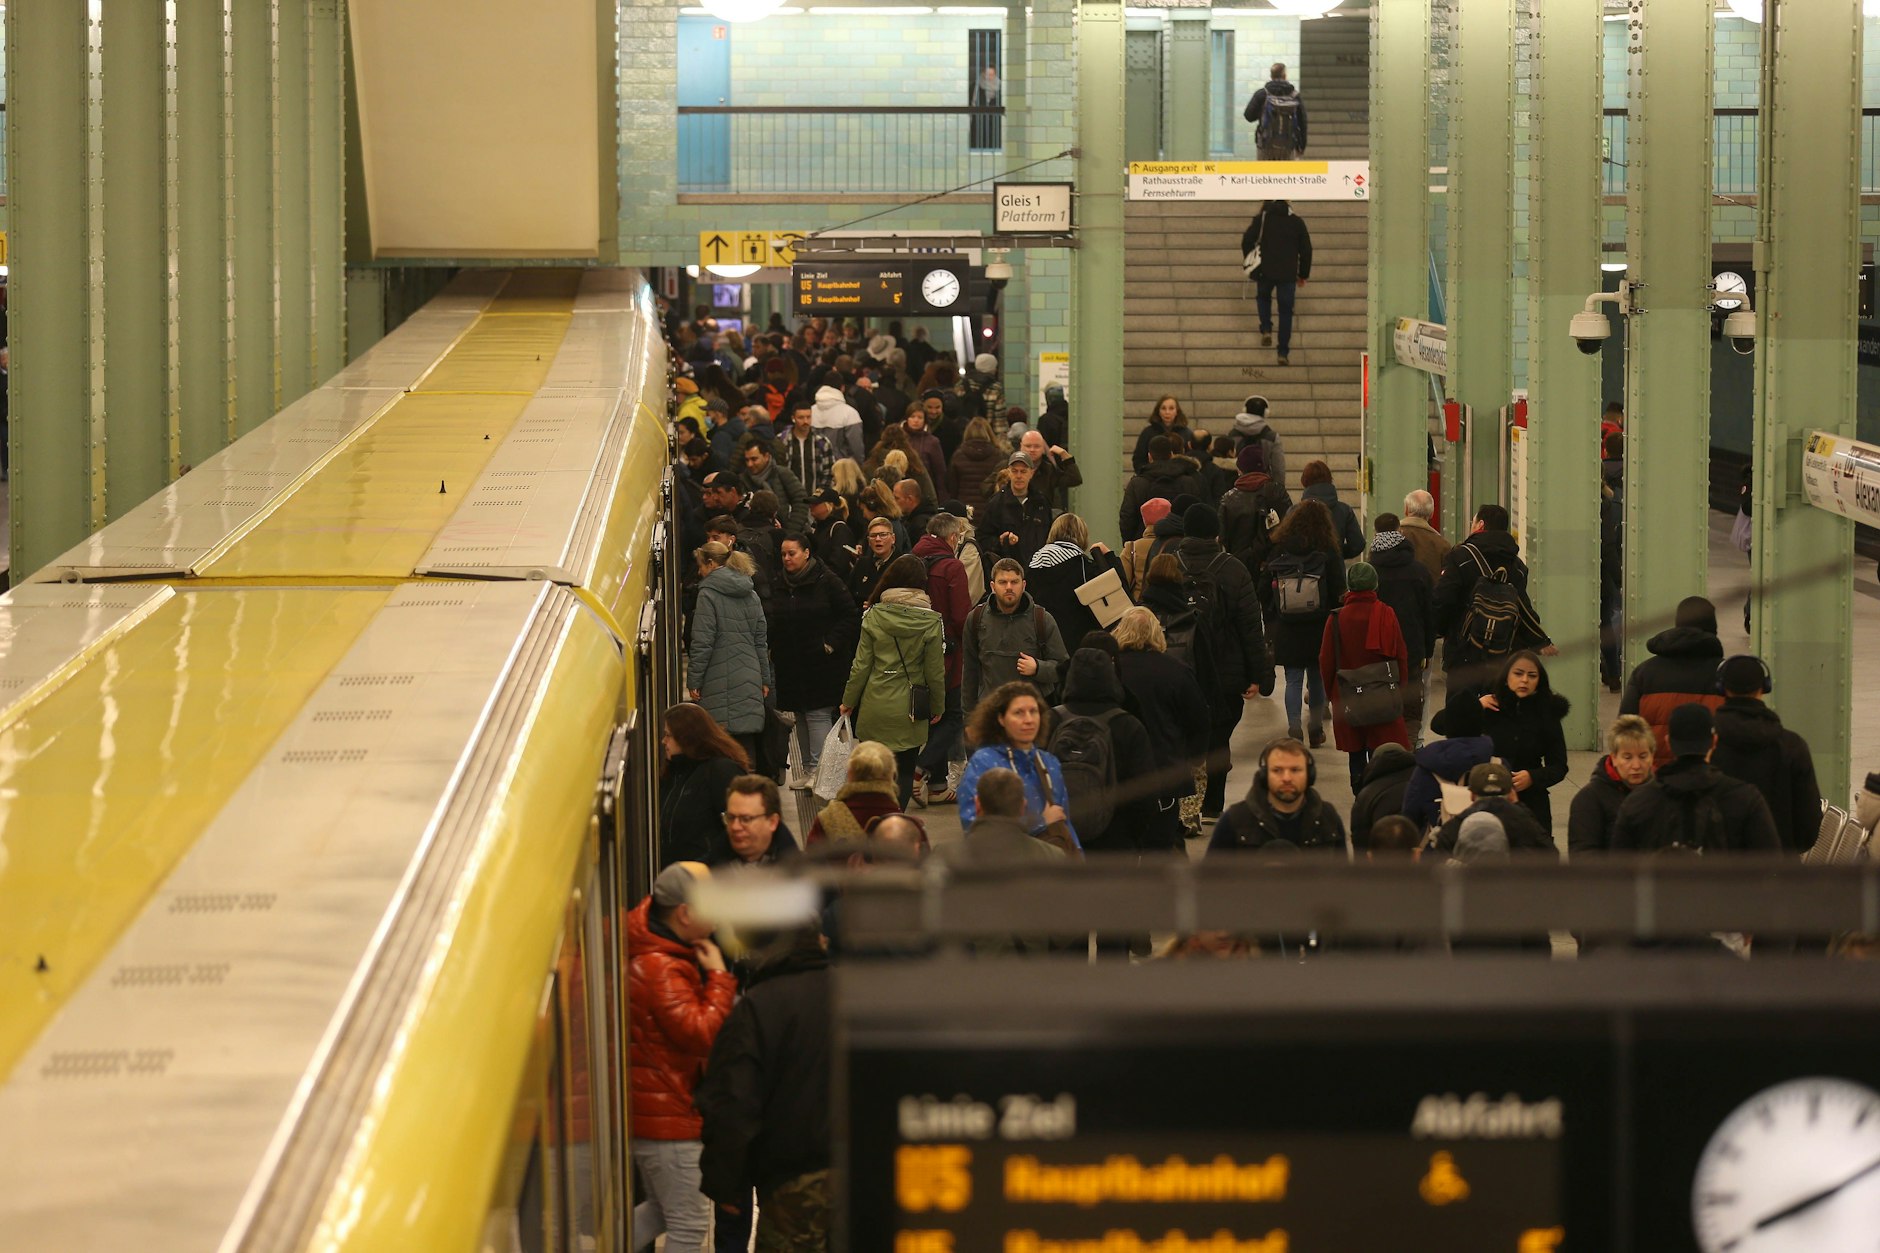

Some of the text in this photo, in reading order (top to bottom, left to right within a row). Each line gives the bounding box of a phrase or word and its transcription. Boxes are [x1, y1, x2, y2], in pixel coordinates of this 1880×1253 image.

[1143, 164, 1179, 174] Ausgang
[1181, 164, 1197, 172] exit
[1143, 176, 1327, 185] Rathausstraße Karl-Liebknecht-Straße
[1143, 189, 1196, 198] Fernsehturm
[1001, 194, 1041, 207] Gleis 1
[1001, 209, 1066, 222] Platform 1
[800, 280, 812, 290] U5
[800, 294, 812, 304] U5
[899, 1092, 1564, 1141] Linie Ziel Abfahrt
[1005, 1154, 1290, 1207] Hauptbahnhof
